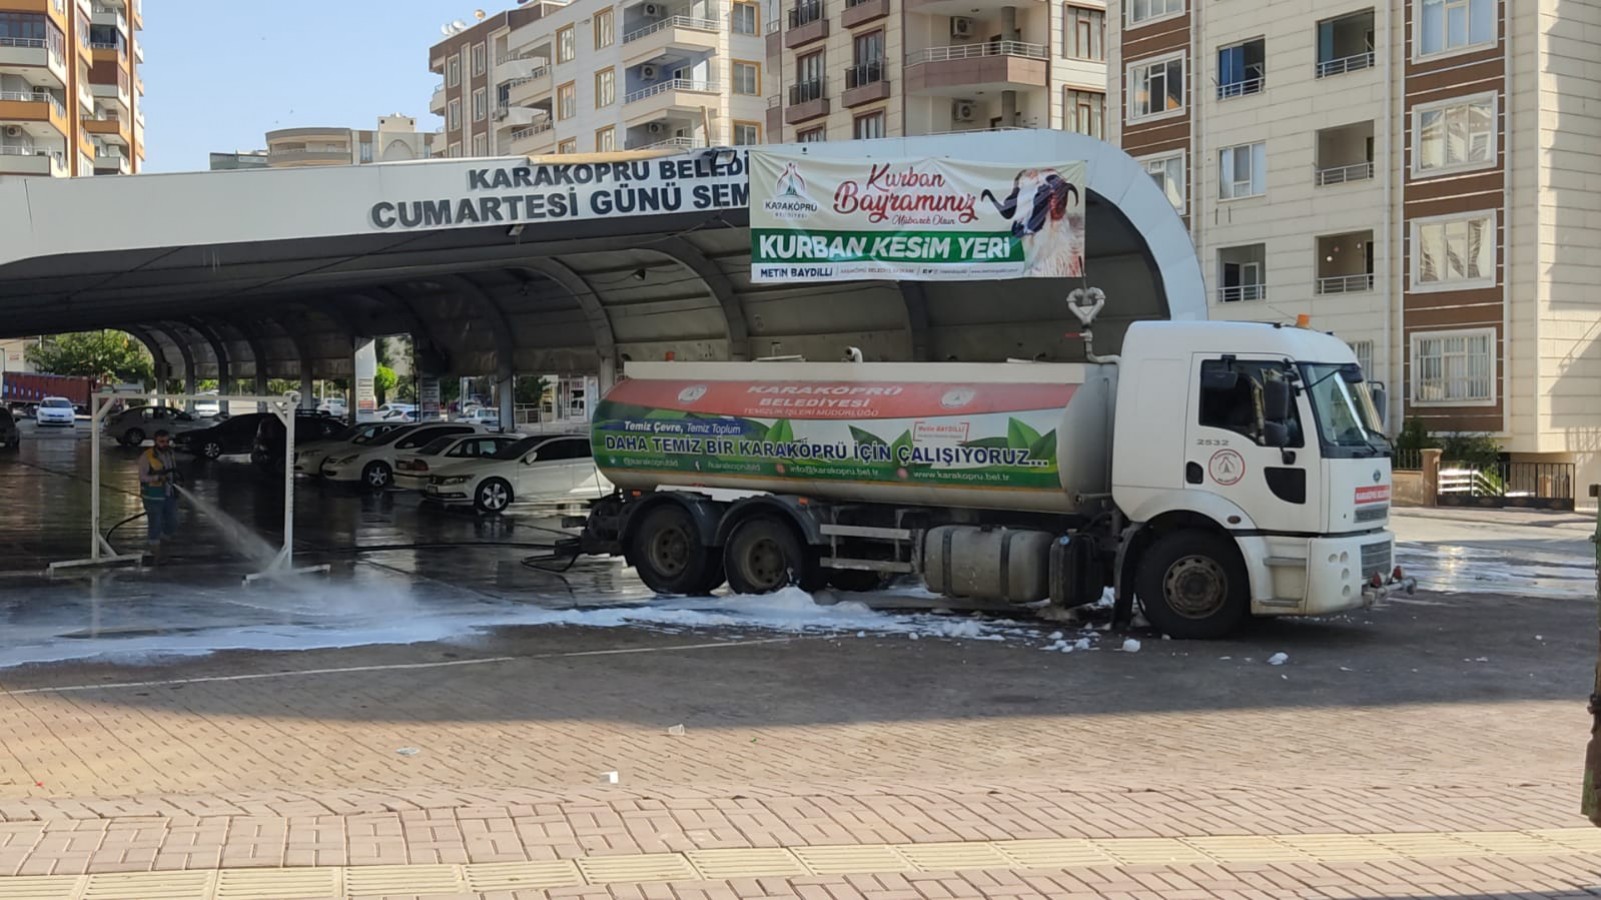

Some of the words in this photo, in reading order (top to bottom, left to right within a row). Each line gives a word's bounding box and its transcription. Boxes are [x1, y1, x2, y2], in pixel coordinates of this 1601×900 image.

[659, 150, 749, 180] BELEDİ
[866, 163, 946, 191] Kurban
[371, 187, 579, 229] CUMARTESİ
[591, 182, 681, 215] GÜNÜ
[692, 183, 749, 209] SEM
[833, 180, 979, 224] Bayramınız
[759, 234, 868, 260] KURBAN
[870, 236, 951, 259] KESİM
[957, 236, 1011, 259] YERİ
[759, 397, 872, 408] BELEDİYESİ
[624, 420, 651, 431] Temiz
[653, 421, 683, 434] Çevre,
[687, 422, 710, 433] Temiz
[712, 422, 741, 435] Toplum
[605, 435, 649, 452] DAHA
[652, 434, 702, 455] TEMİZ
[706, 435, 736, 456] BİR
[740, 440, 848, 461] KARAKÖPRÜ
[853, 442, 892, 464] İÇİN
[898, 446, 1049, 468] ÇALIŞIYORUZ...
[1196, 438, 1229, 446] 2532
[913, 470, 1010, 482] www.karakopru.bel.tr
